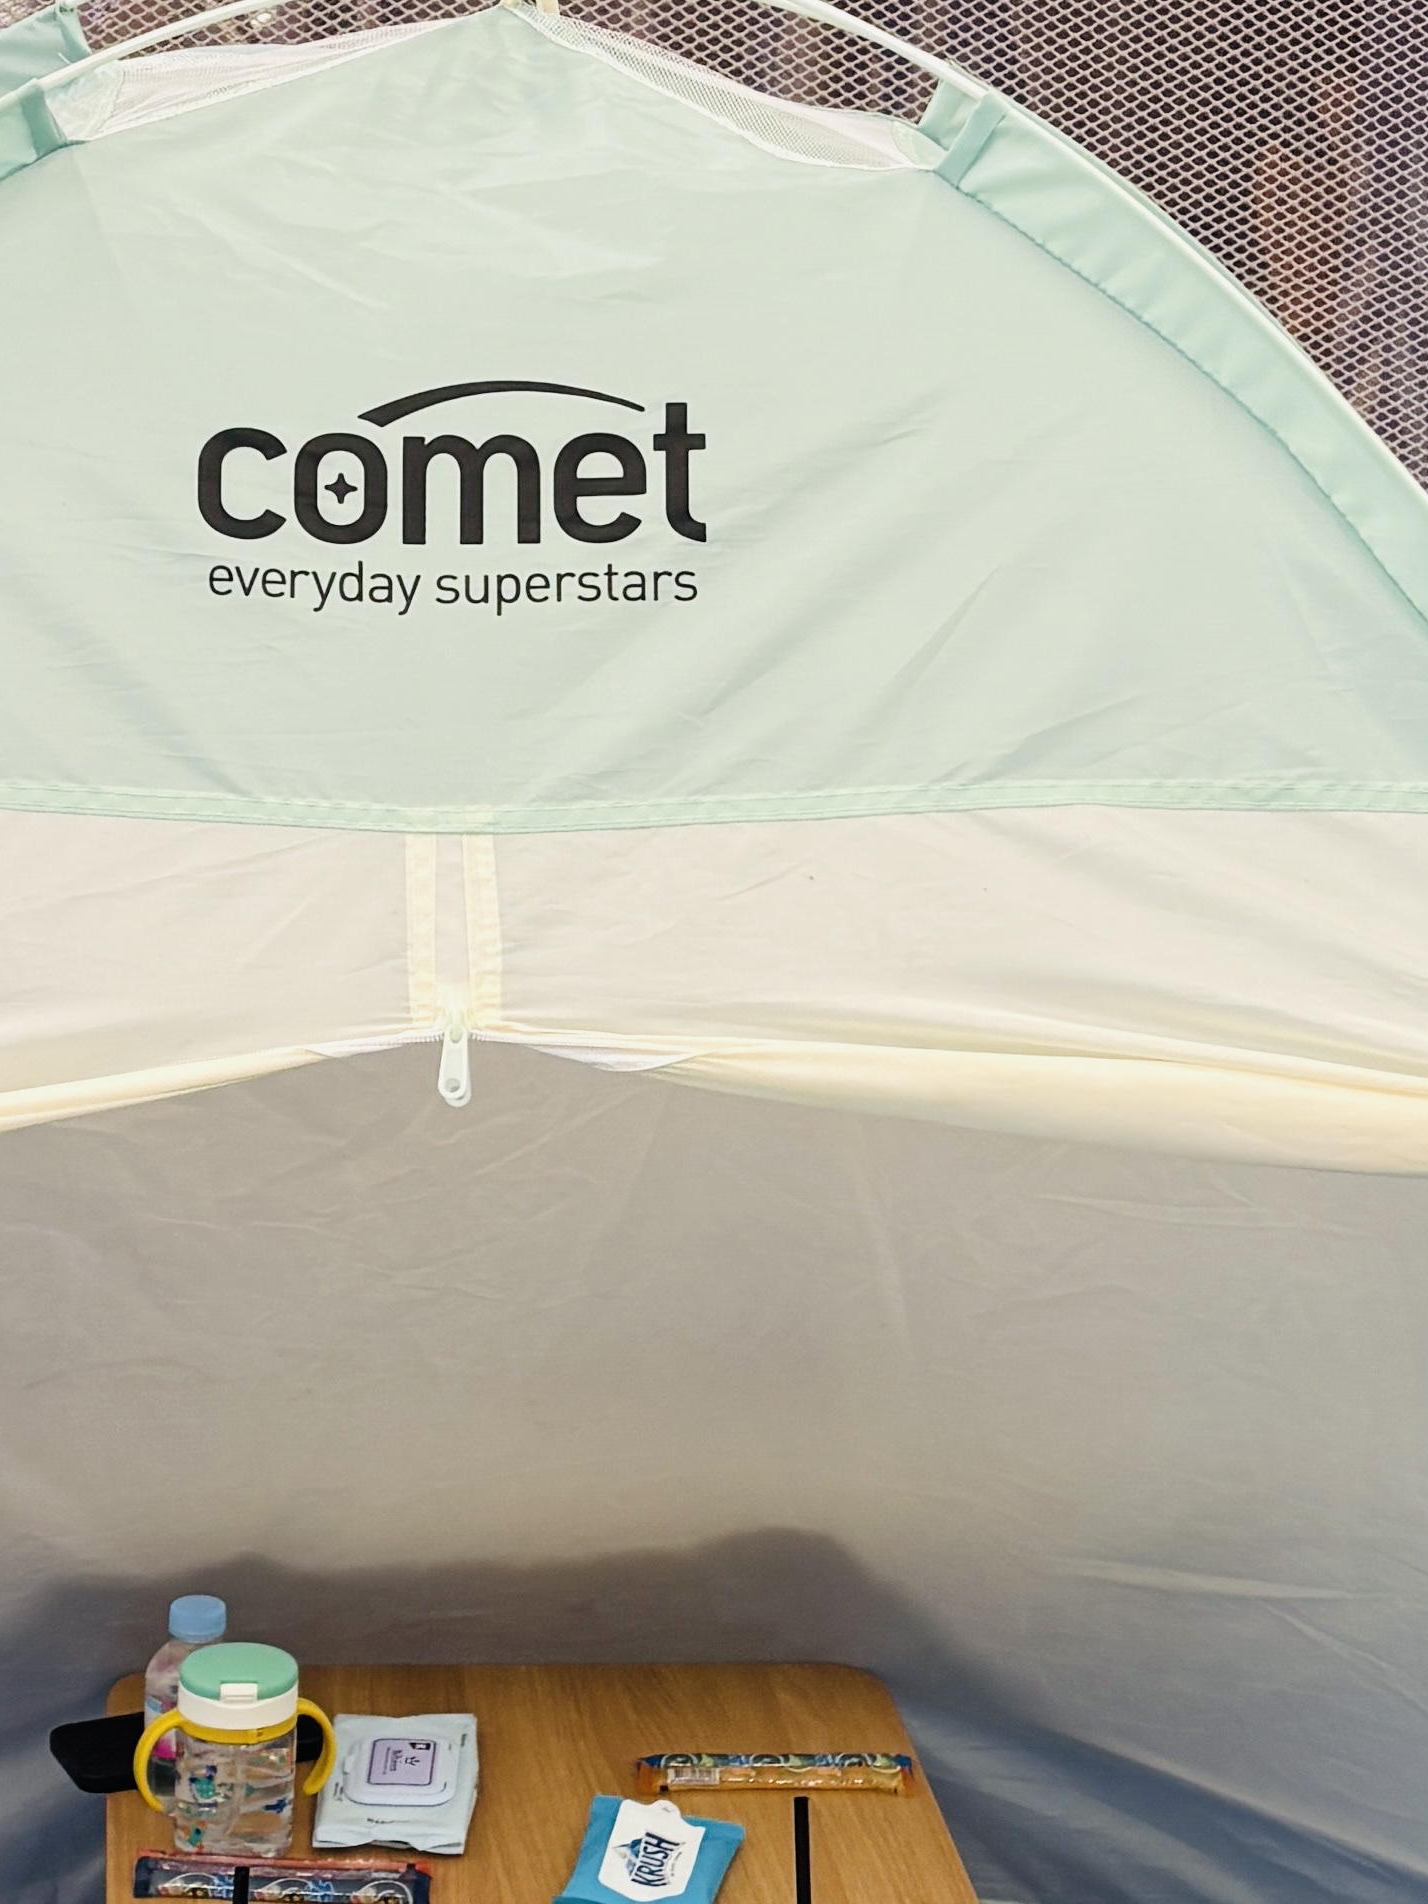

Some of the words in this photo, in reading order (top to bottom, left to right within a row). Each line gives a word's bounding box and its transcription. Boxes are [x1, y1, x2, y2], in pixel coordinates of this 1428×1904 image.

[197, 399, 708, 545] comet
[208, 560, 421, 616] everyday
[435, 563, 698, 616] superstars
[631, 1831, 681, 1887] KRUSH
